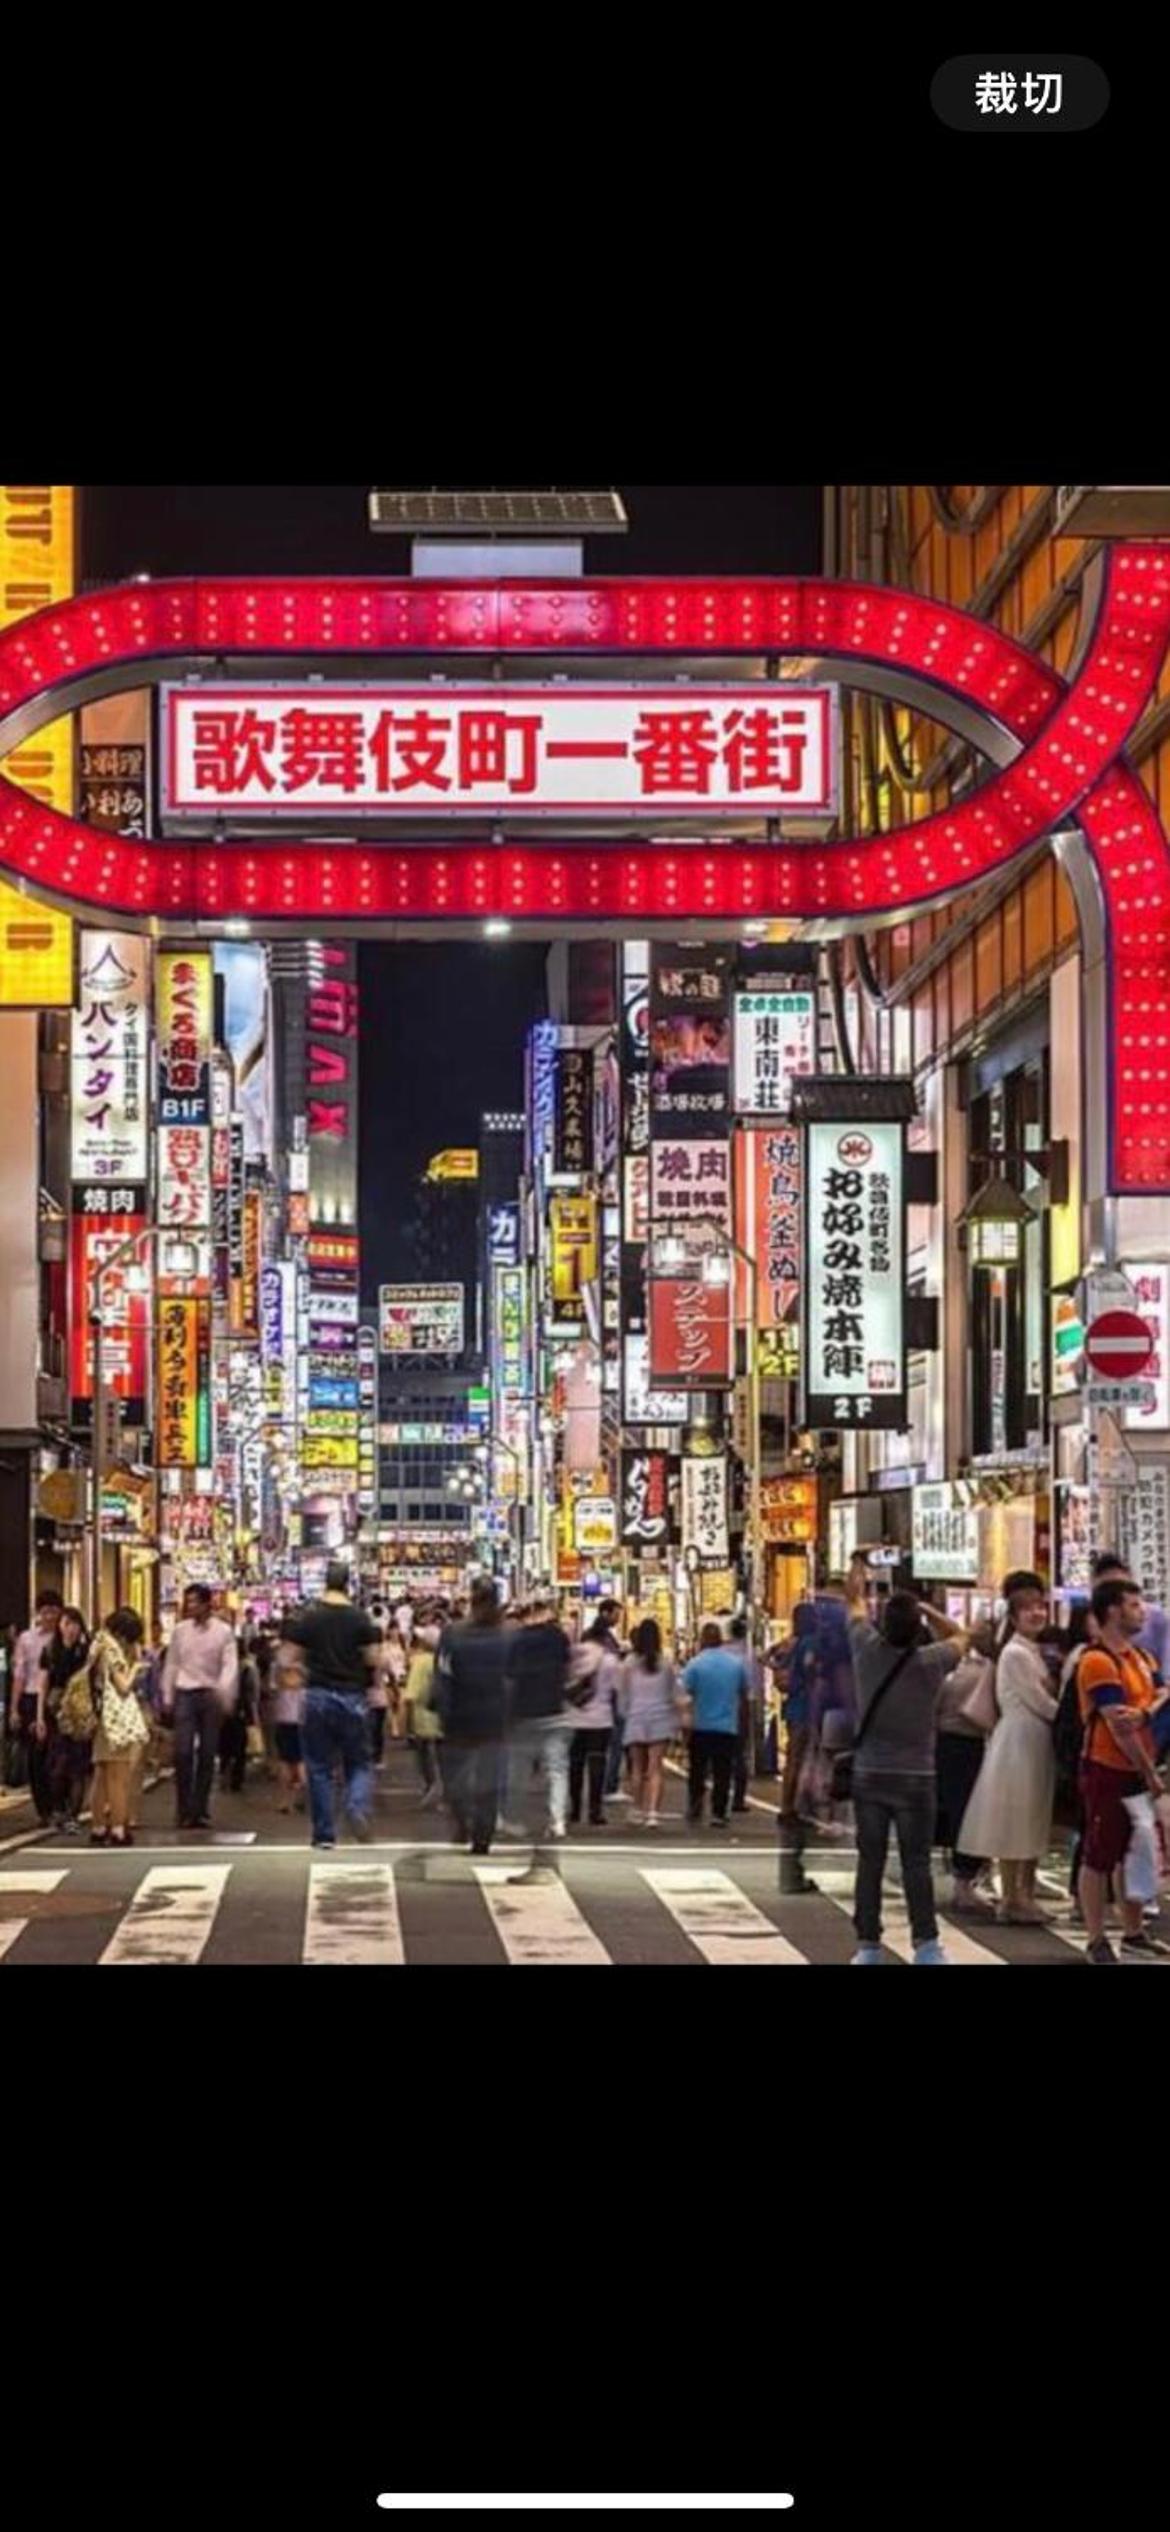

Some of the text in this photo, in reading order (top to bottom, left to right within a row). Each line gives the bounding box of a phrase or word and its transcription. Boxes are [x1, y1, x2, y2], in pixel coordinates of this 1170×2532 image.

[192, 709, 808, 793] 歌舞伎町一番街
[754, 1016, 780, 1110] 東南荘
[162, 1100, 206, 1118] B1F
[94, 1160, 123, 1176] 3F
[657, 1146, 728, 1182] 焼肉
[83, 1189, 135, 1213] 焼肉
[822, 1167, 865, 1379] お好み焼本陣
[834, 1397, 873, 1420] 2F
